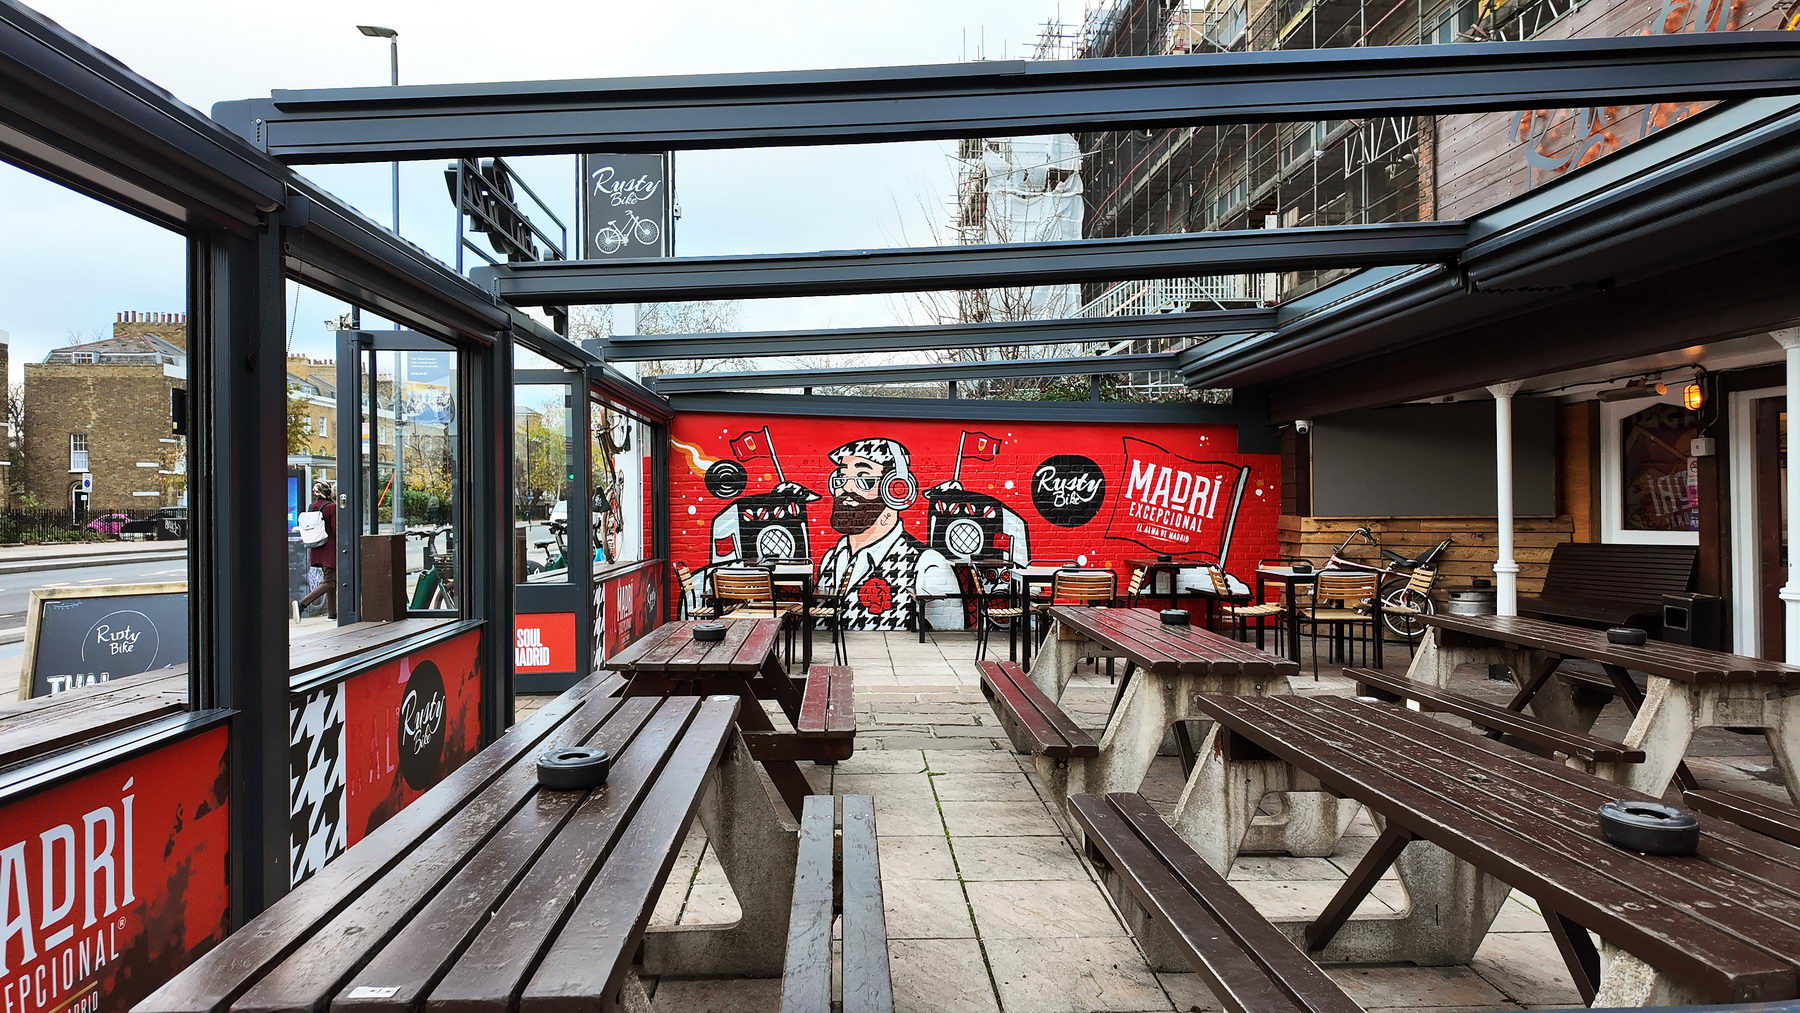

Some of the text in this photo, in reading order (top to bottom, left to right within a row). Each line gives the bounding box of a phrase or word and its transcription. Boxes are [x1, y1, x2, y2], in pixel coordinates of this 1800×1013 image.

[592, 167, 661, 200] Rusty
[610, 192, 638, 207] Bike
[1036, 466, 1102, 502] Rusty
[1053, 491, 1080, 507] Bike
[1124, 459, 1223, 519] MADRÍ
[1129, 501, 1202, 533] EXCEPCIONAL
[1136, 524, 1190, 543] EL ALMA DE MADRID
[97, 624, 141, 644] Rusty
[109, 640, 134, 655] Bike
[517, 628, 542, 648] SOUL
[401, 689, 446, 746] Rusty
[413, 724, 431, 755] Bike
[0, 776, 135, 979] ADRÍ
